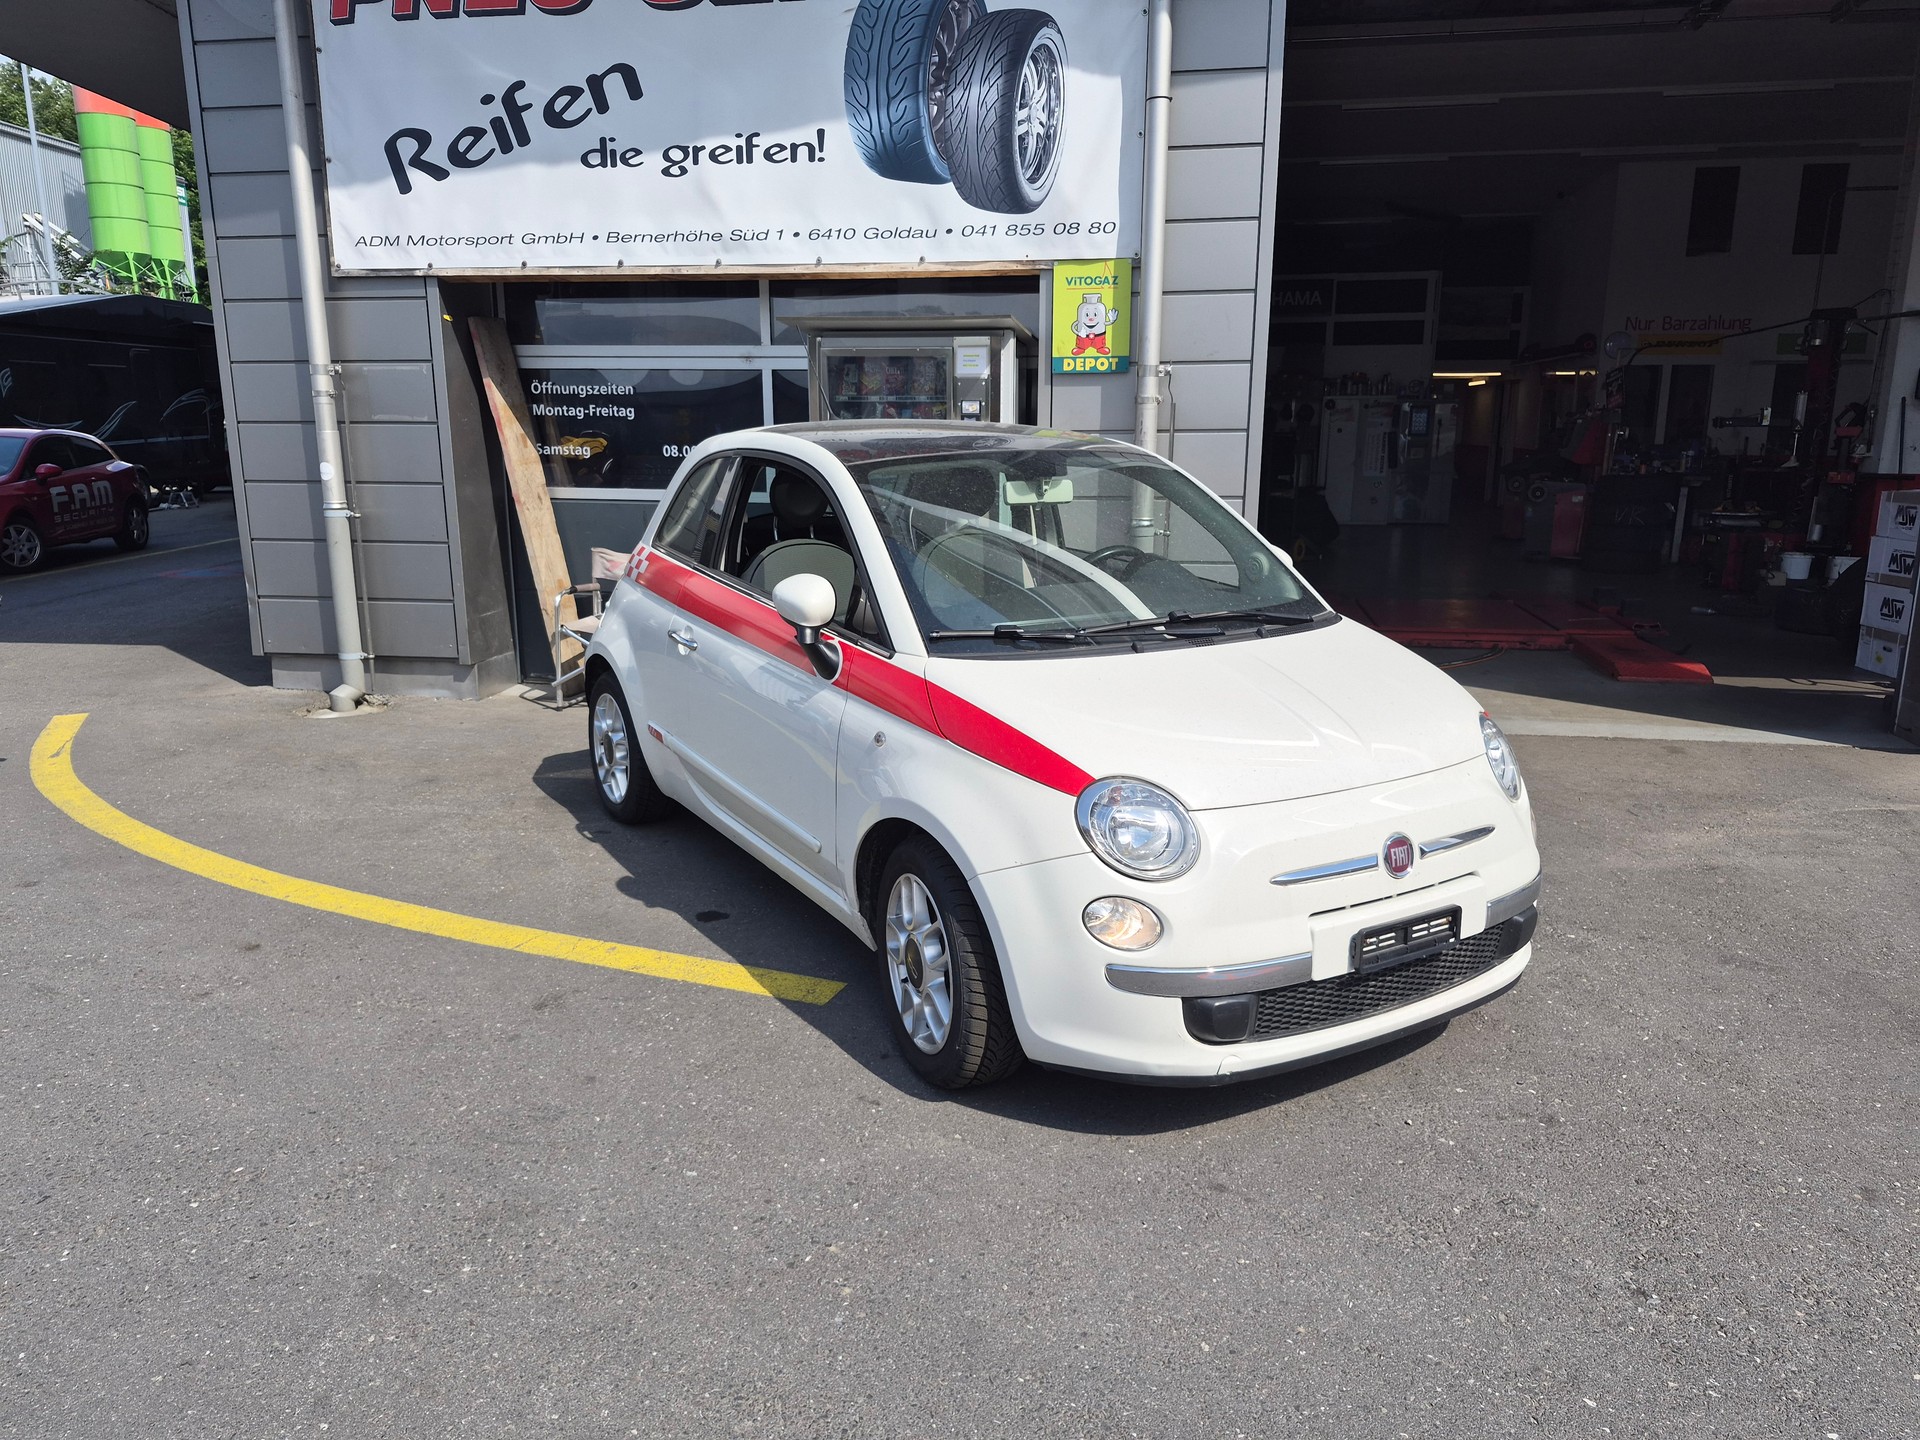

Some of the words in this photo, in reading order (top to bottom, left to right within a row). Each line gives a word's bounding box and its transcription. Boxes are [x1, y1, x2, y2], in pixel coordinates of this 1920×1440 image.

[383, 62, 644, 195] Reifen
[580, 136, 645, 169] die
[660, 127, 826, 178] greifen!
[354, 234, 401, 247] ADM
[406, 233, 515, 248] Motorsport
[521, 231, 585, 245] GmbH
[605, 229, 723, 243] Bernerhöhe
[729, 228, 770, 241] Süd
[776, 228, 784, 241] 1
[808, 227, 857, 240] 6410
[863, 226, 938, 240] Goldau
[961, 224, 997, 237] 041
[1004, 223, 1046, 236] 855
[1052, 221, 1081, 235] 08
[1087, 221, 1117, 235] 80
[1624, 316, 1655, 331] Nur
[1662, 314, 1752, 332] Barzahlung
[1062, 357, 1119, 372] DEPOT
[531, 380, 634, 397] Öffnungszeiten
[532, 403, 635, 420] Montag-Freitag
[536, 443, 591, 459] Samstag
[54, 506, 114, 523] SECURITY
[1888, 553, 1915, 576] MSW
[1880, 597, 1905, 620] MSW
[1390, 845, 1409, 868] FIAT
